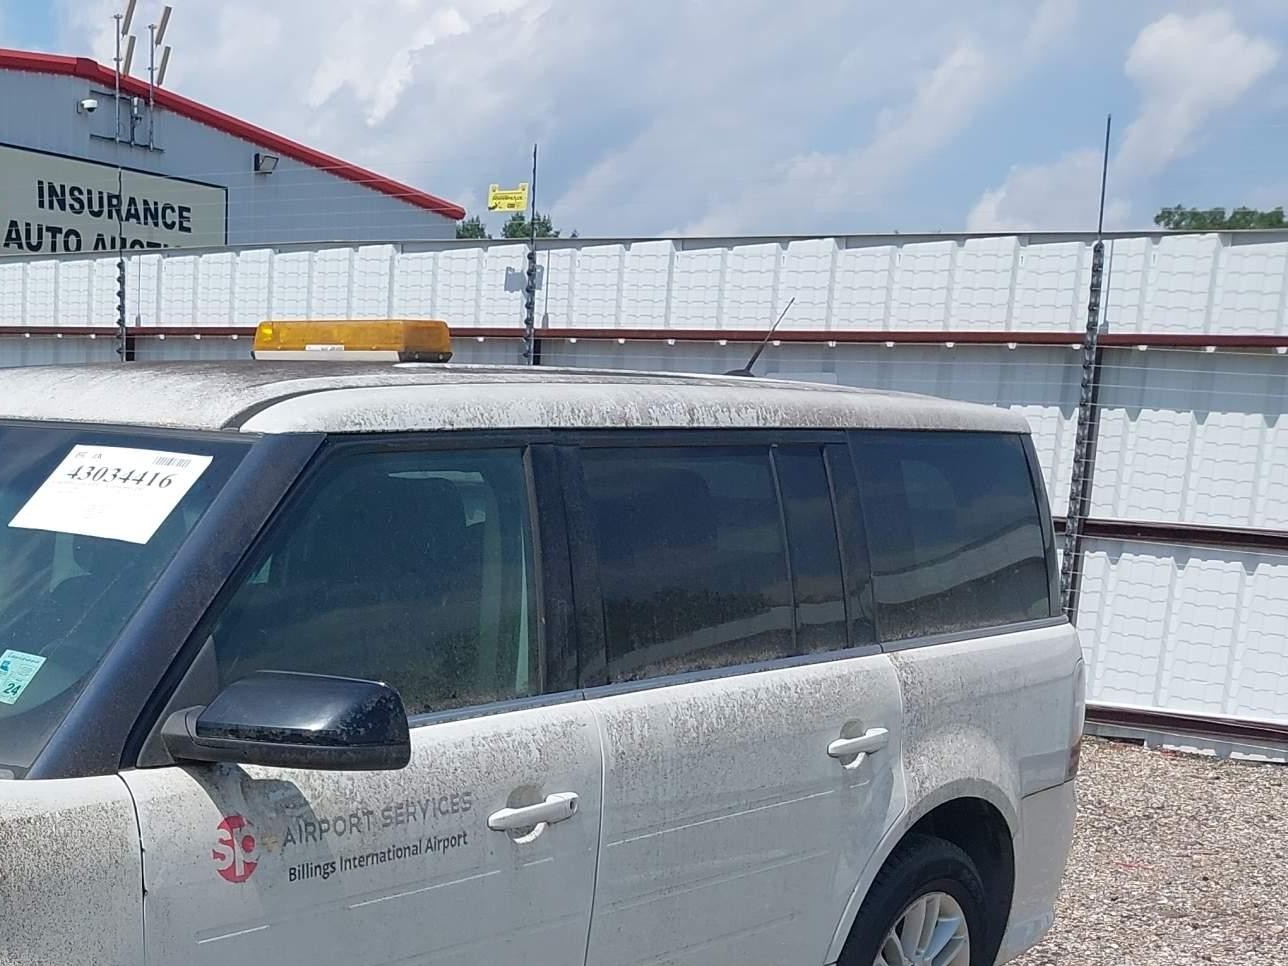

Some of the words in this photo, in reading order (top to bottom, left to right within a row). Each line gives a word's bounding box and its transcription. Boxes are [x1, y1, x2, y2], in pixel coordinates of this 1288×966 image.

[37, 179, 192, 234] INSURANCE
[3, 219, 82, 253] AUTO
[66, 465, 179, 489] 43034416
[3, 682, 22, 696] 24
[283, 809, 374, 847] AIRPORT
[380, 791, 473, 829] SERVICES
[288, 860, 337, 883] Billings
[340, 838, 422, 873] International
[424, 831, 469, 856] Airport
